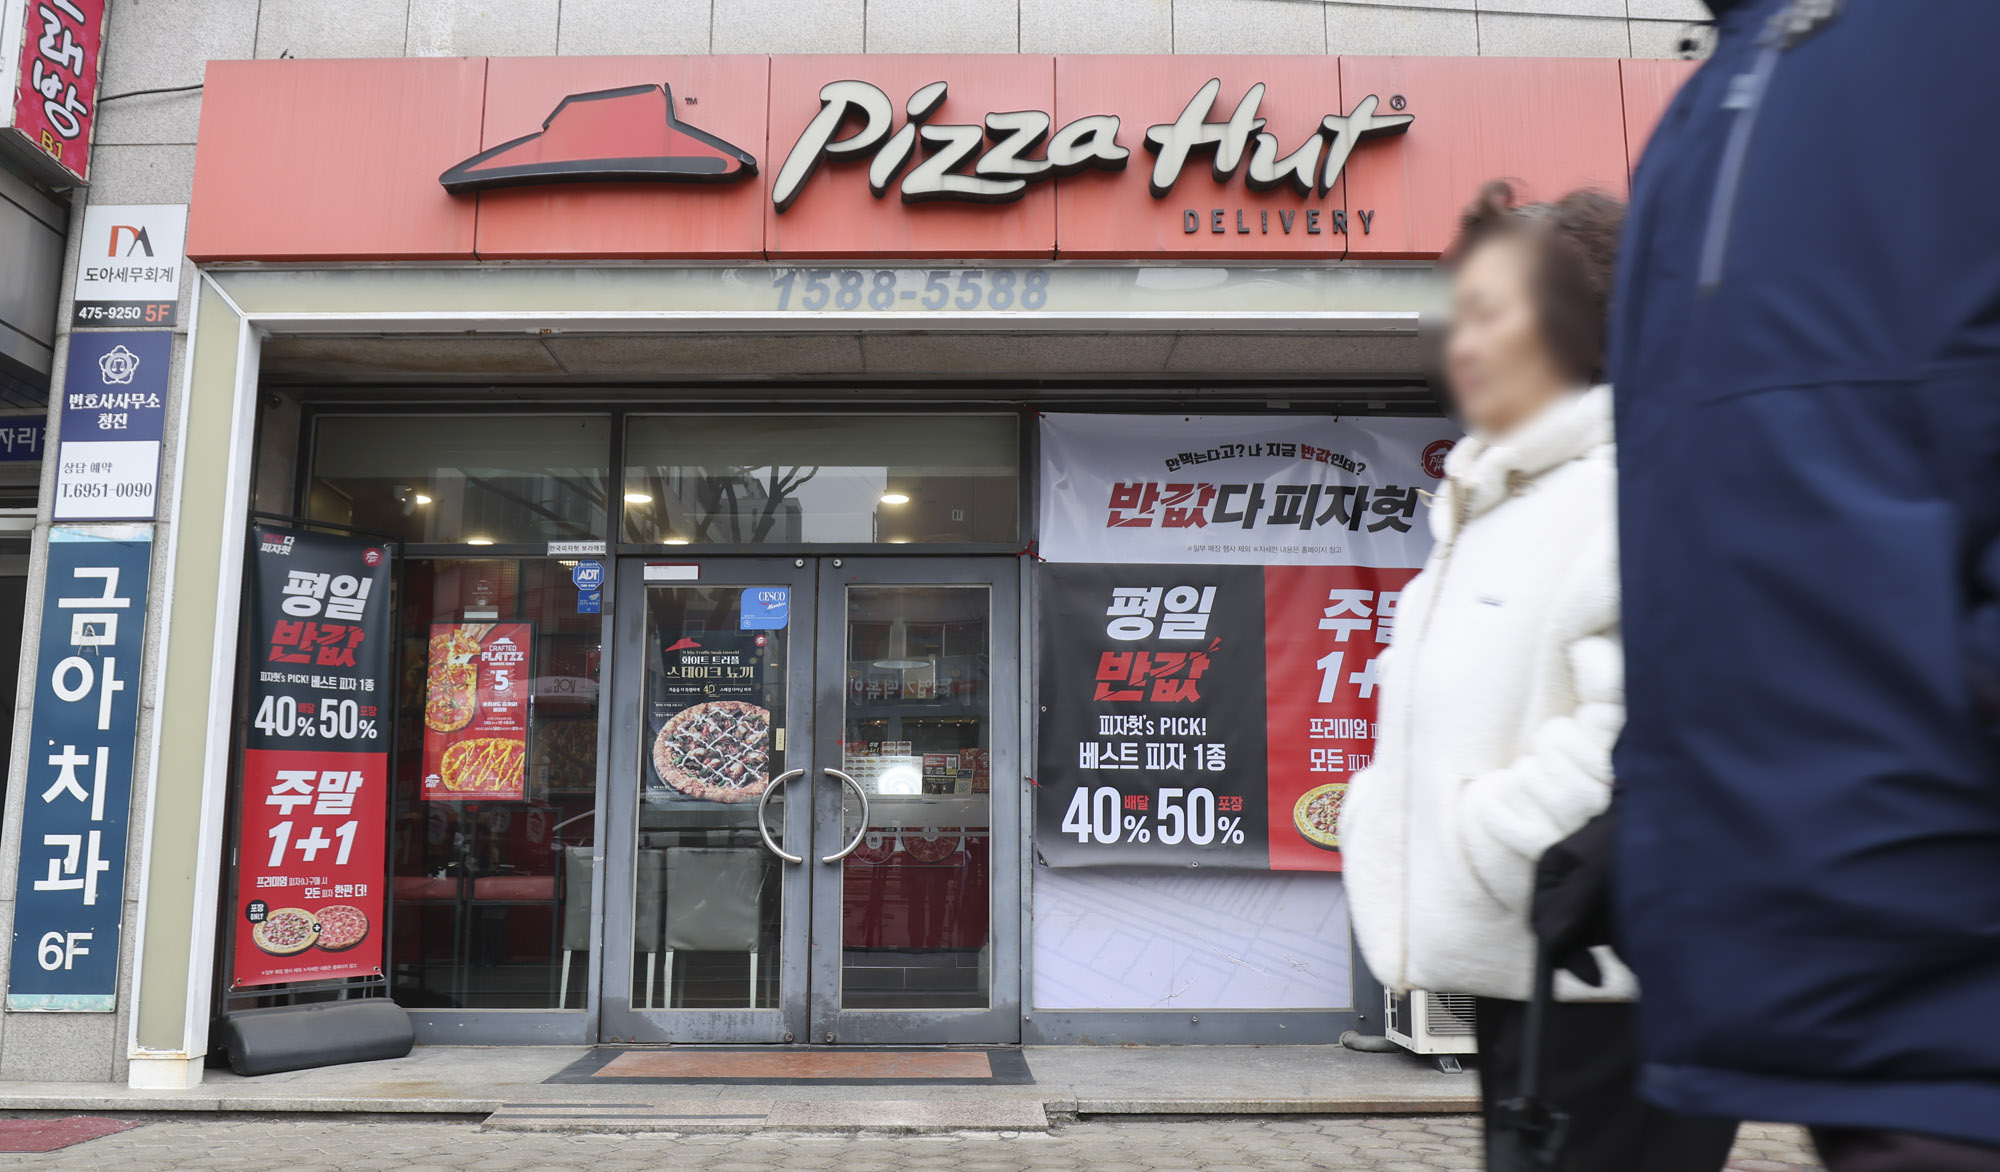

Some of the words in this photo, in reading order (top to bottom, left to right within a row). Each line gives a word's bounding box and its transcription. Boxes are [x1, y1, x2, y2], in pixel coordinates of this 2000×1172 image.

[31, 0, 88, 140] 래방
[41, 129, 64, 160] B1
[771, 79, 1131, 215] Pizza
[1143, 77, 1416, 199] Hut
[1183, 208, 1375, 235] DELIVERY
[84, 266, 174, 283] 도아세무회계
[771, 269, 1050, 311] 1588-5588
[78, 306, 141, 320] 475-9250
[144, 304, 171, 322] 5F
[68, 393, 161, 410] 변호사사무소
[97, 412, 129, 430] 청진
[1248, 443, 1263, 457] 나
[1266, 443, 1297, 458] 지금
[63, 462, 87, 474] 상담
[90, 461, 113, 474] 예약
[60, 482, 153, 499] T.6951-0090
[260, 542, 293, 556] 피자헛
[577, 569, 600, 581] ADT
[281, 569, 373, 622] 평일
[758, 591, 786, 602] CESCO
[1106, 585, 1217, 641] 평일
[268, 619, 366, 668] 반값
[481, 651, 524, 662] FLATZZ
[681, 655, 710, 665] 화이트
[711, 655, 740, 665] 트러플
[287, 673, 309, 684] PICK!
[311, 675, 337, 689] 베스트
[339, 677, 357, 691] 피자
[359, 678, 375, 692] 1종
[666, 666, 723, 679] 스테이크
[1093, 643, 1216, 703] 반값
[254, 695, 316, 737] 40%
[319, 698, 378, 740] 50%
[1099, 714, 1155, 736] 피자헛's
[1160, 717, 1207, 736] PICK!
[33, 566, 131, 906] 금아치과
[1309, 718, 1368, 739] 프리미엄
[1079, 742, 1139, 771] 베스트
[1145, 742, 1187, 772] 피자
[1193, 743, 1226, 772] 1종
[1310, 748, 1344, 772] 모든
[264, 769, 364, 816] 주말
[1061, 786, 1151, 844] 40%
[1124, 794, 1150, 811] 배달
[1156, 787, 1245, 845] 50%
[1218, 795, 1243, 811] 포장
[267, 820, 358, 867] 1+1
[256, 875, 288, 888] 프리미엄
[304, 887, 321, 899] 모든
[334, 885, 353, 898] 한판
[355, 884, 367, 897] 더!
[249, 903, 264, 913] 포장
[250, 913, 264, 921] ONLY
[37, 931, 93, 971] 6F
